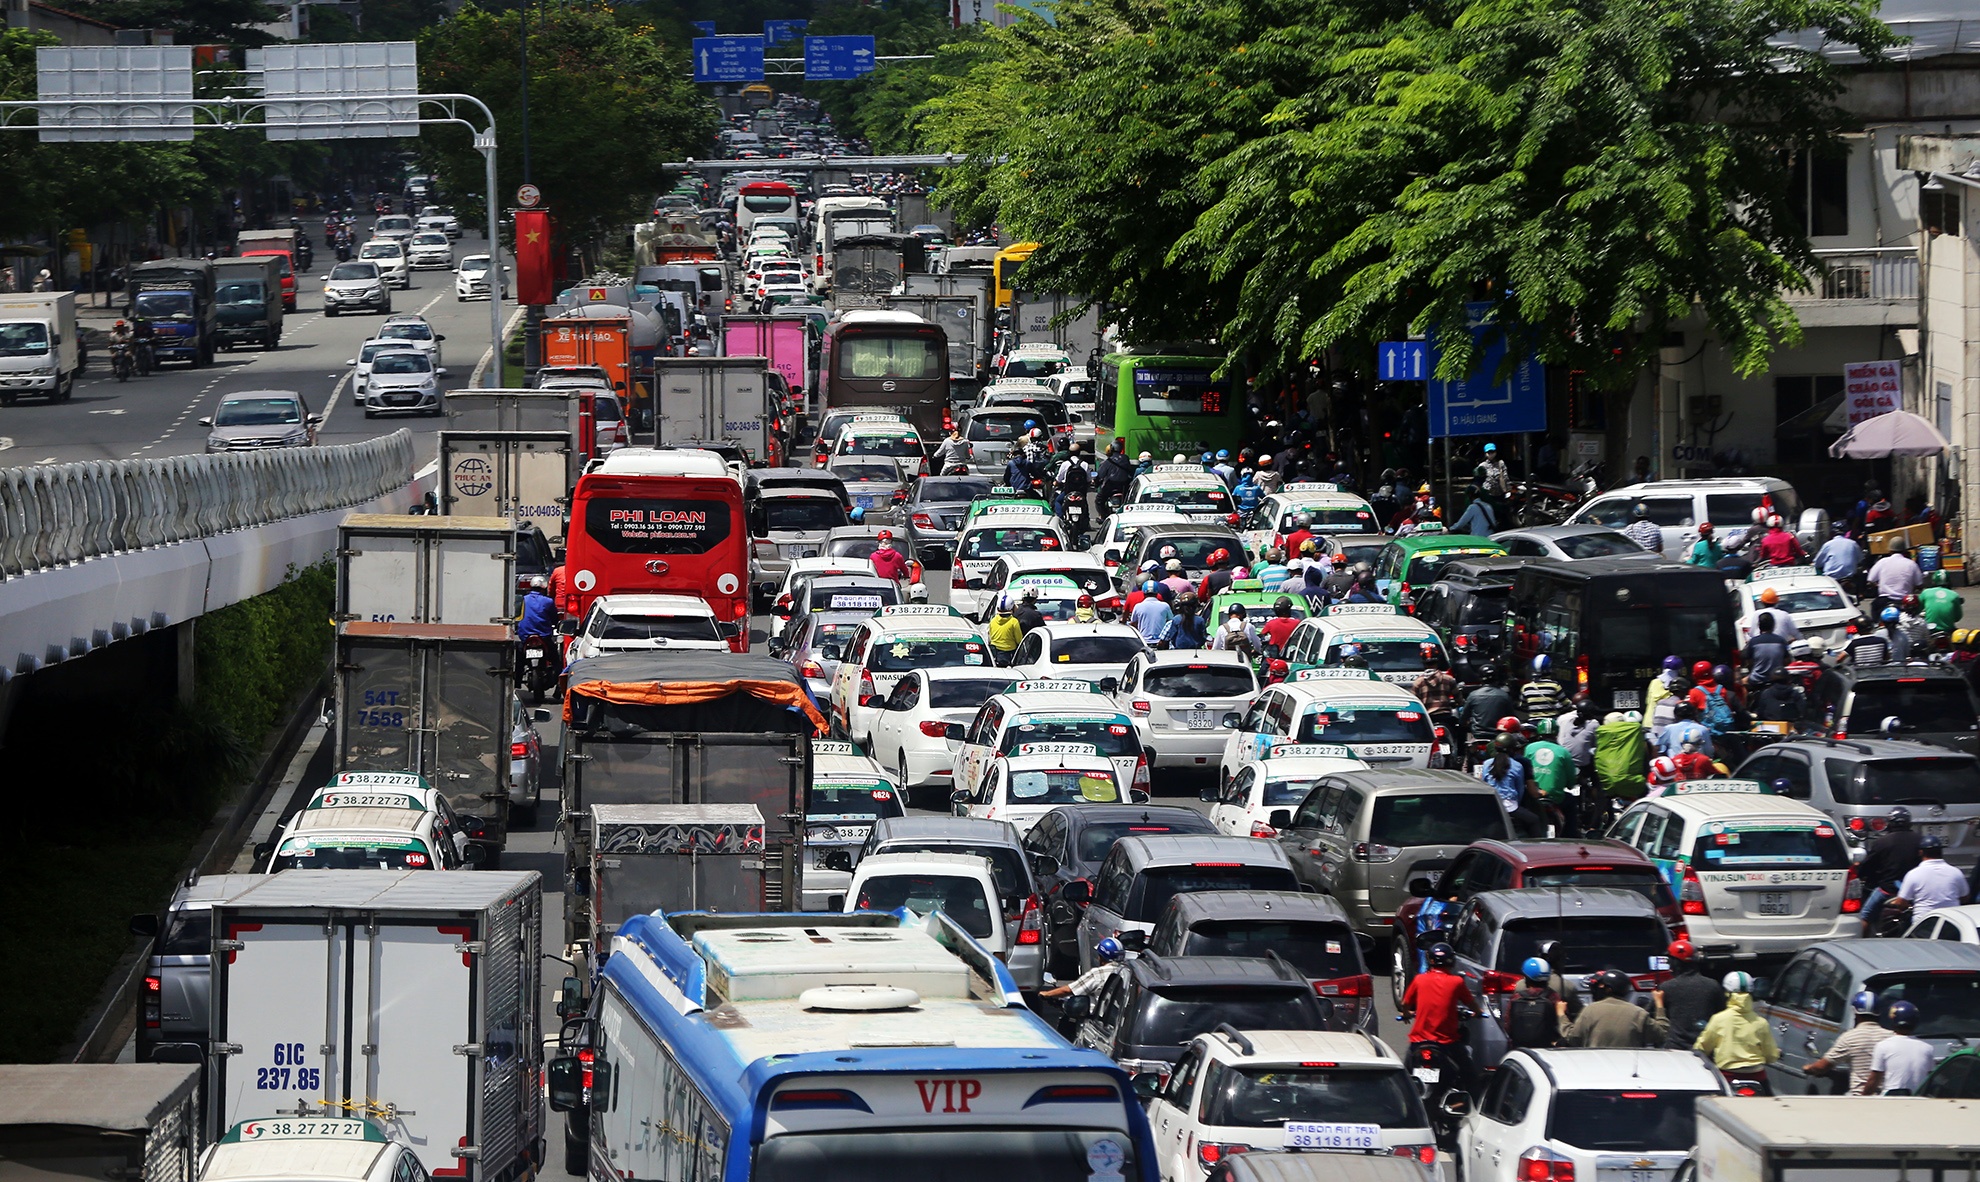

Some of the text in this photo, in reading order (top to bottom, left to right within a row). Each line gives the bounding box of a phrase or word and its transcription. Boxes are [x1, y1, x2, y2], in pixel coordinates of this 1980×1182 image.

[559, 333, 569, 342] XE
[519, 505, 561, 517] 51C-04036
[610, 509, 706, 524] PHI LOAN
[1345, 605, 1369, 613] 38.27
[1370, 605, 1380, 613] 27
[1312, 669, 1367, 677] 38.27 27 27
[1033, 682, 1087, 690] 38.27 27 27
[364, 690, 399, 706] 54T
[358, 711, 403, 728] 7558
[1193, 712, 1207, 720] 51F
[1110, 725, 1127, 734] 7765
[823, 744, 851, 753] 27 27
[1038, 745, 1095, 754] 38.27 27 27
[1289, 746, 1346, 755] 38.27 27 27
[1376, 746, 1429, 754] 38.27 27 27
[1123, 759, 1134, 767] 27
[356, 774, 417, 785] 38.27 27 27
[1697, 783, 1758, 791] 38.27 27 27
[872, 791, 890, 799] 4624
[343, 796, 408, 806] 38.27 27 27
[840, 829, 869, 838] 38.27
[405, 854, 425, 863] 8140
[1783, 873, 1813, 882] 38.27
[1816, 873, 1828, 881] 27
[1831, 872, 1843, 881] 27
[273, 1042, 305, 1066] 61C
[256, 1067, 320, 1091] 237.85
[914, 1078, 982, 1113] VIP
[272, 1123, 362, 1136] 38.27 27 27
[1288, 1125, 1333, 1133] SAIGON
[1355, 1126, 1378, 1134] TAXI
[1293, 1135, 1372, 1146] 38 118 118
